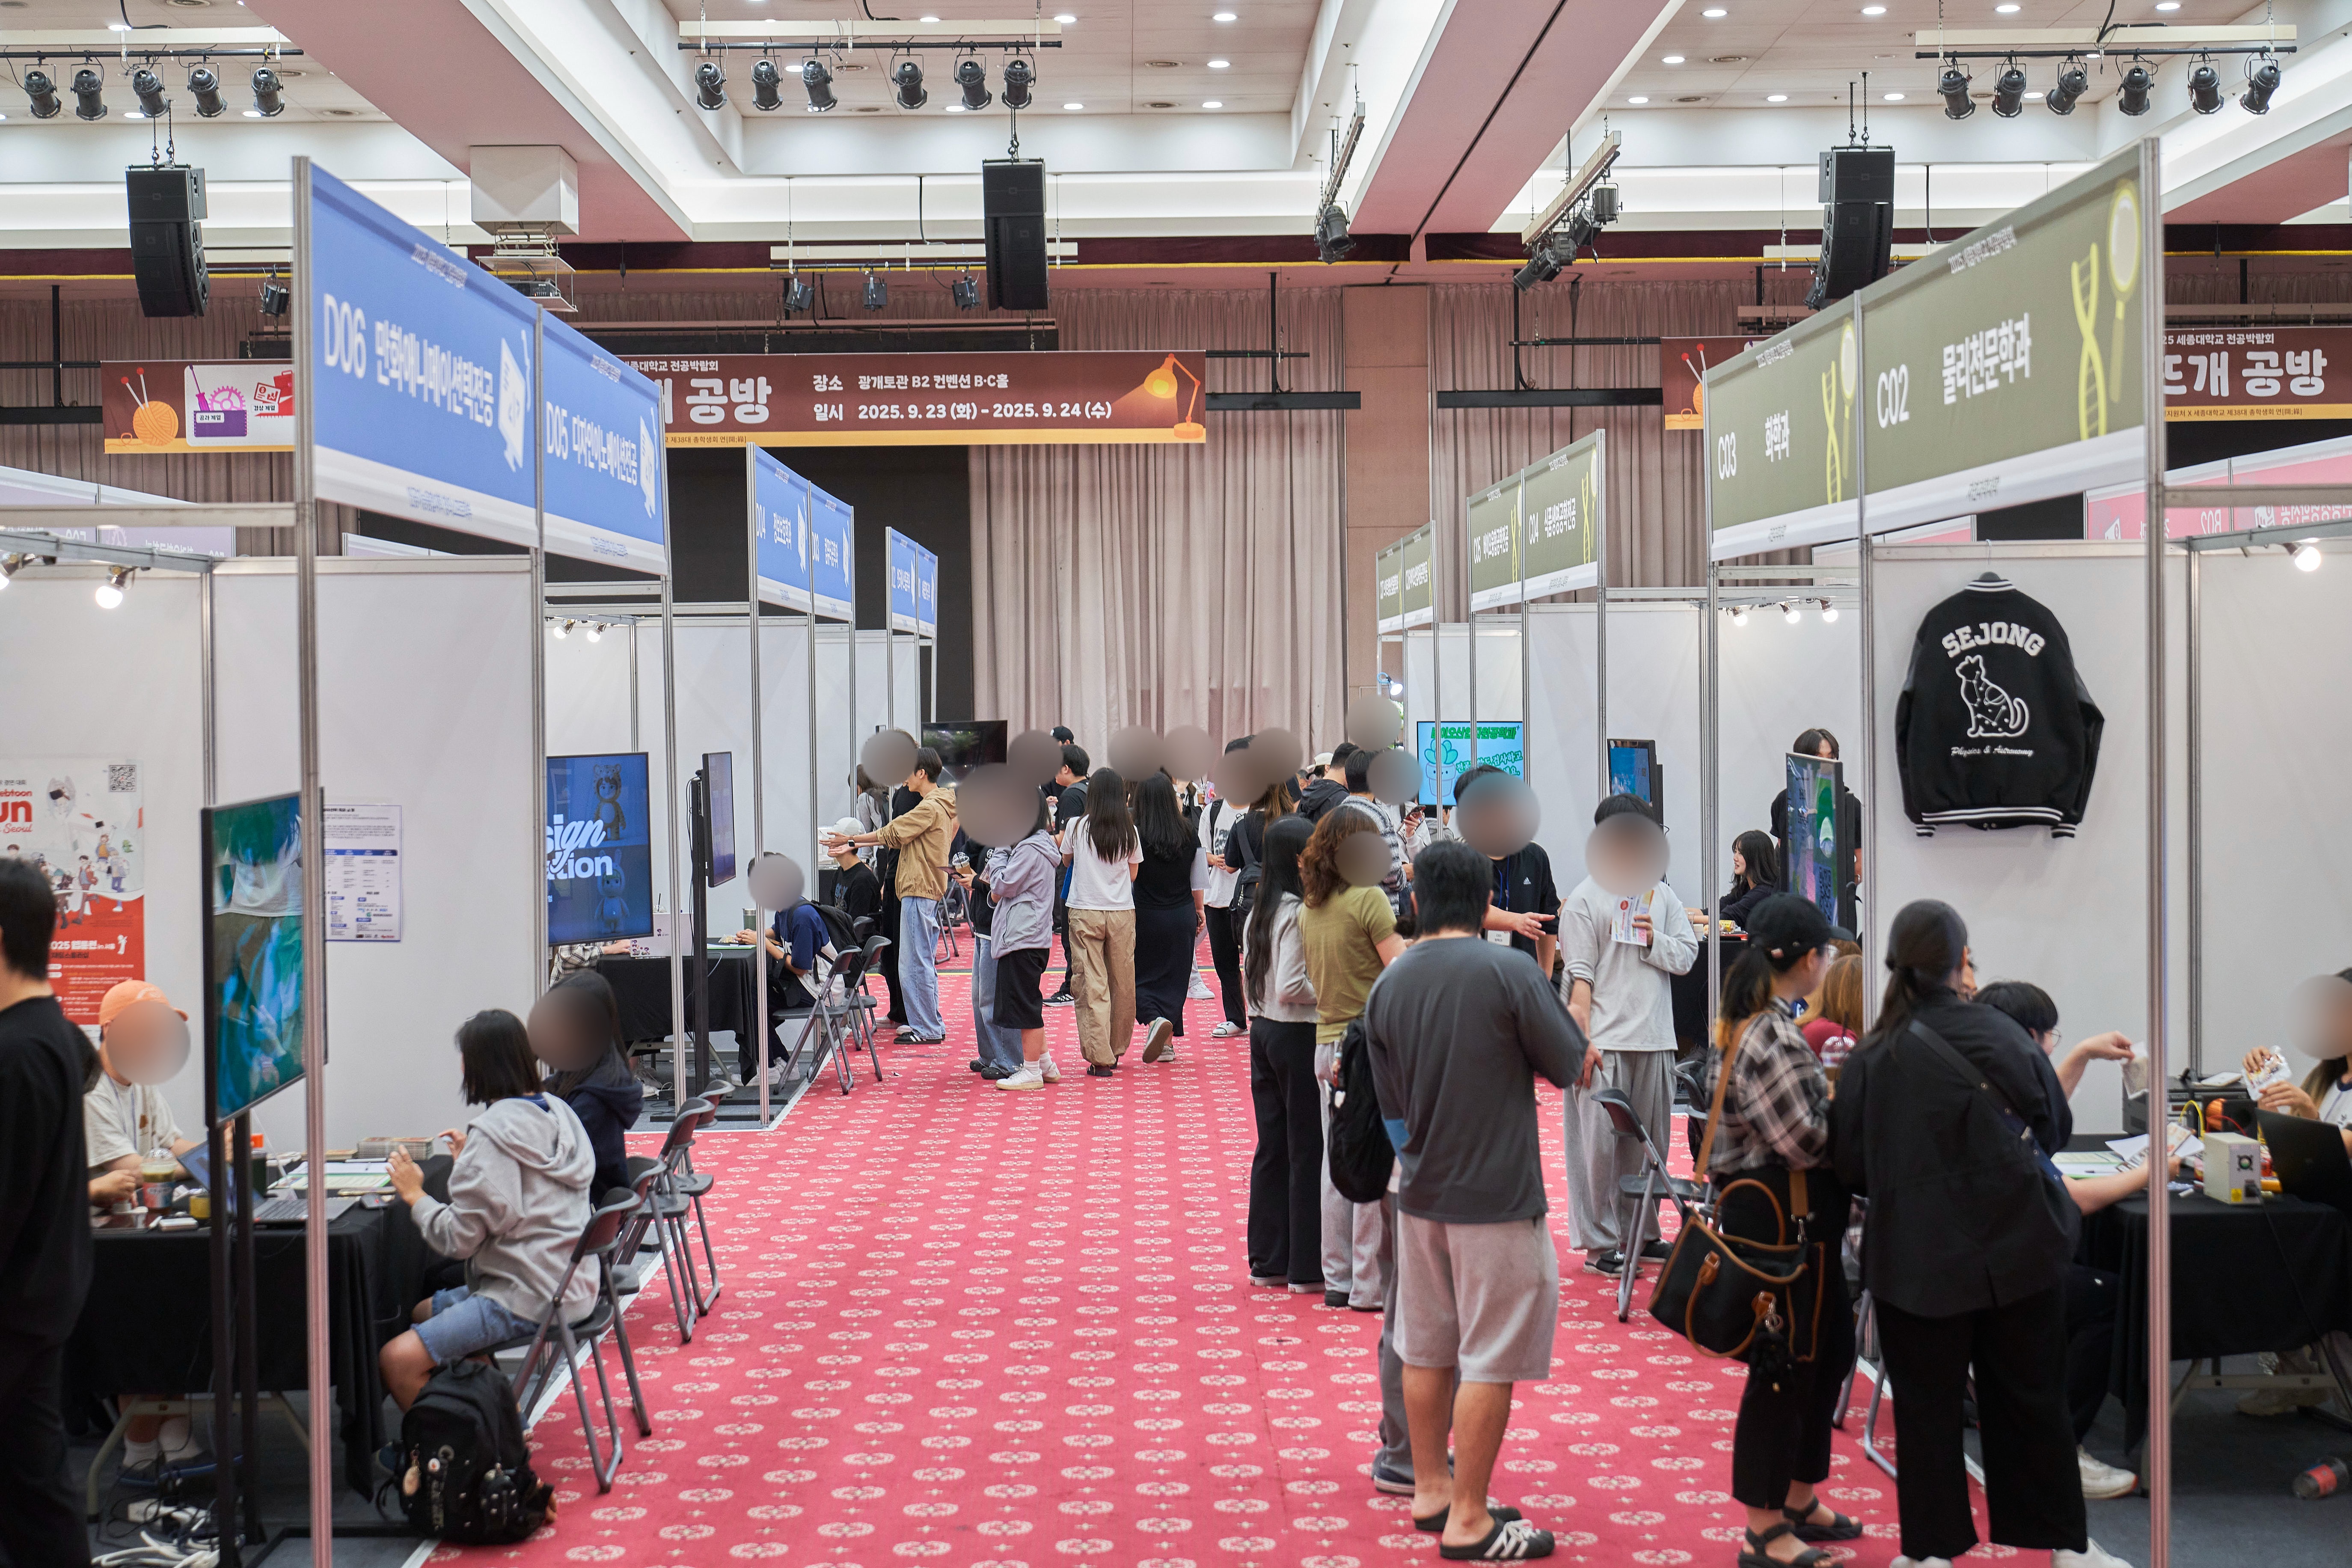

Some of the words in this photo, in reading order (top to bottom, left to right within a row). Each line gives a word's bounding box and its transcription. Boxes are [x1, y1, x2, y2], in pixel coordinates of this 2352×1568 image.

[324, 293, 367, 379] D06
[2161, 335, 2174, 343] 25
[2177, 333, 2224, 345] 세종대학교
[2227, 333, 2274, 344] 전공박람회
[671, 360, 719, 371] 전공박람회
[1877, 364, 1910, 428] C02
[1942, 312, 2032, 405] 물리천문학과
[2242, 348, 2328, 397] 공방
[813, 375, 843, 392] 장소
[858, 374, 909, 390] 광개토관
[912, 376, 930, 388] B2
[933, 374, 971, 389] 컨벤션
[686, 376, 772, 424] 공방
[813, 404, 843, 421] 일시
[546, 401, 568, 460] D05
[572, 415, 638, 486] 디자인이노베이션전공
[671, 435, 692, 443] 제38대
[693, 435, 718, 443] 총학생회
[1718, 432, 1737, 480] C03
[1764, 410, 1790, 463] 화학과
[756, 503, 766, 539] D04
[1529, 512, 1539, 545] C04
[1544, 497, 1576, 538] 식품생명공학전공
[1473, 536, 1482, 564] C05
[1942, 622, 2045, 658] SEJONG
[1492, 751, 1523, 766] 검사하고
[1951, 746, 1981, 757] Physics
[1984, 745, 1990, 753] &
[1993, 745, 2033, 757] Astronomy
[3, 823, 33, 833] Seoul
[546, 814, 606, 874] sign
[50, 941, 70, 950] 025
